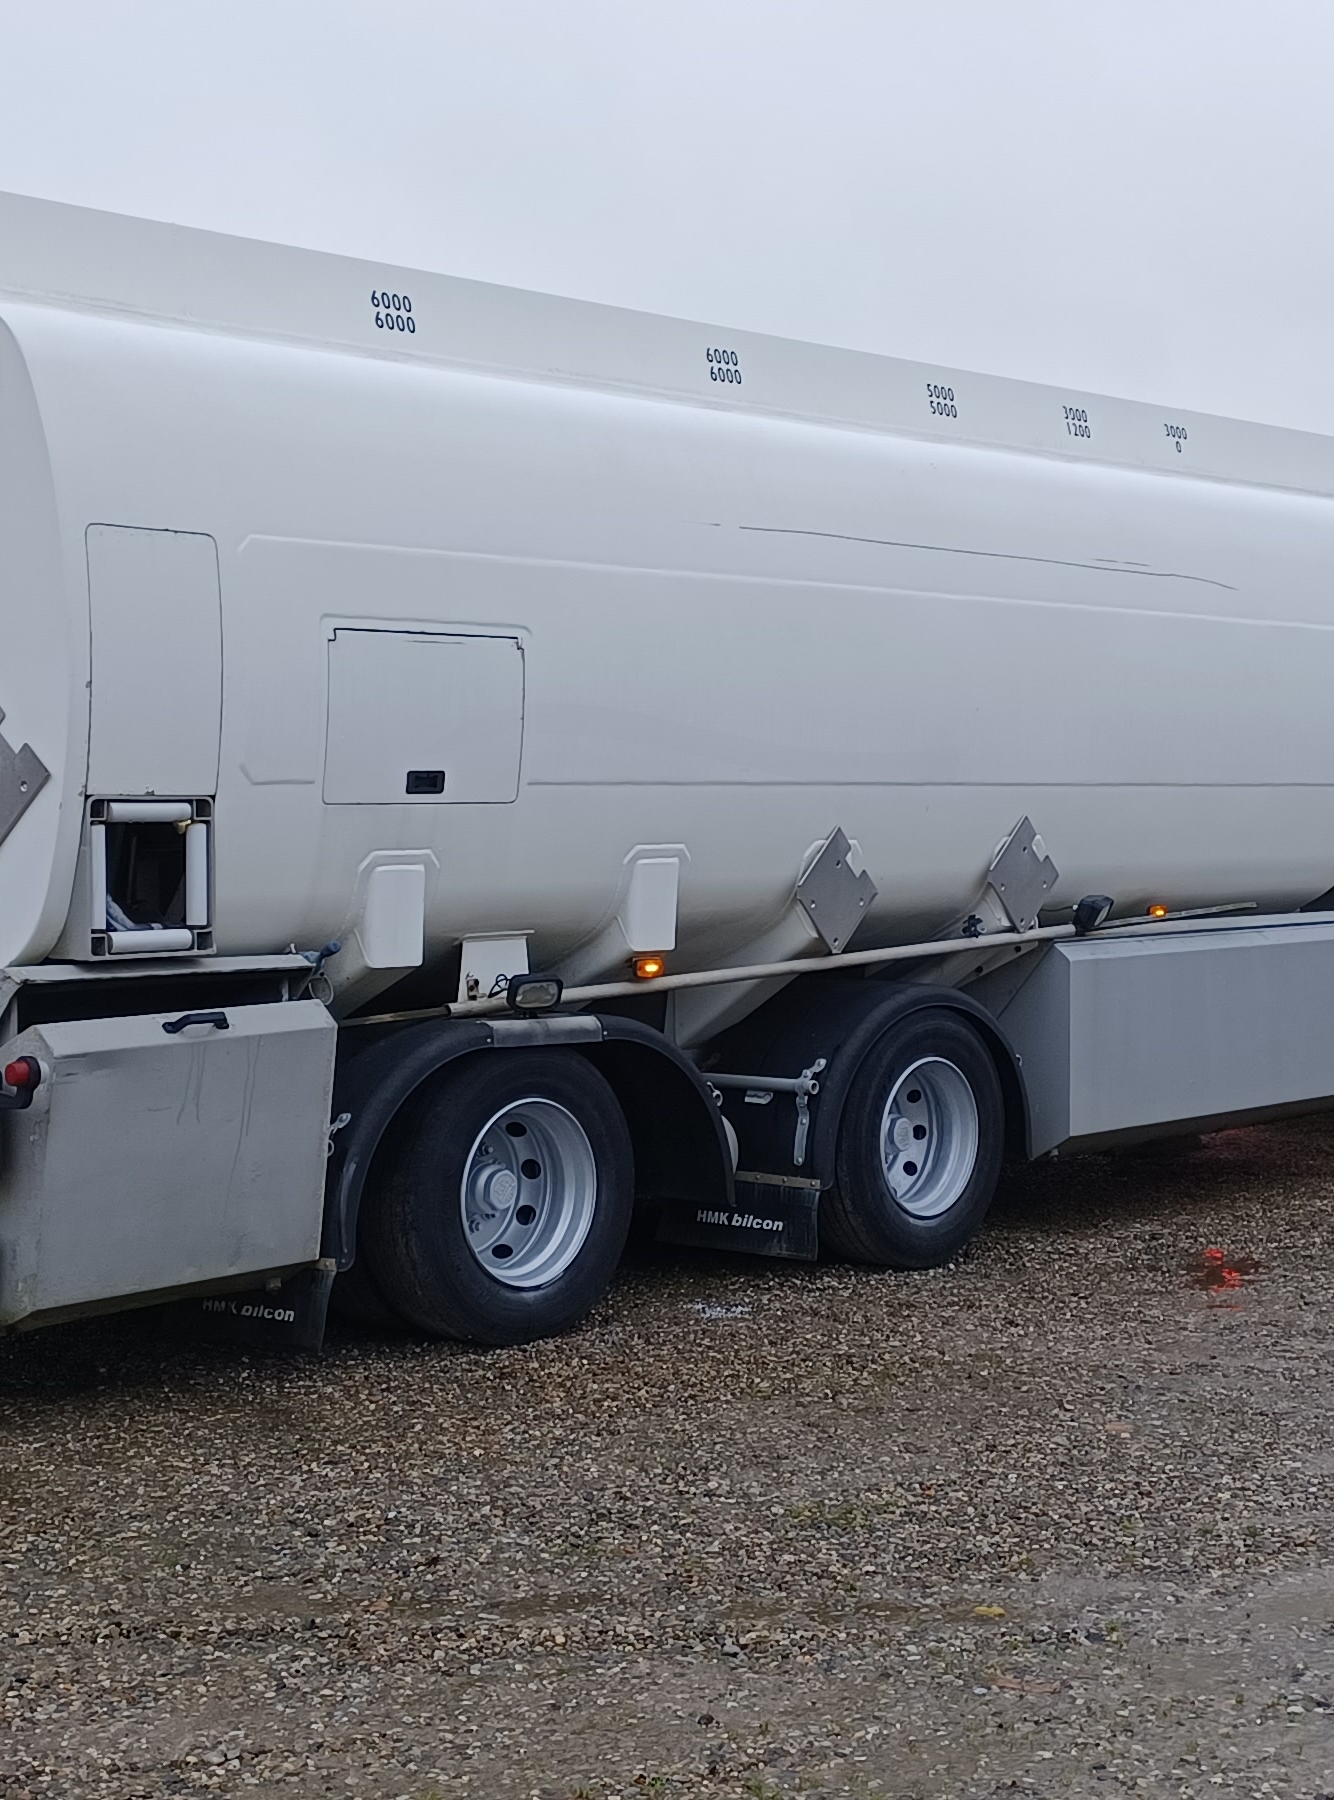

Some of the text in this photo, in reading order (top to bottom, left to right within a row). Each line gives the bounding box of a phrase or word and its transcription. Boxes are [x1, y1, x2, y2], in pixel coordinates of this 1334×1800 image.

[370, 289, 412, 314] 6000
[374, 310, 416, 334] 6000
[706, 347, 739, 367] 6000
[709, 365, 742, 385] 6000
[926, 383, 955, 402] 5000
[929, 400, 958, 419] 5000
[1062, 405, 1088, 423] 3000
[1066, 421, 1091, 439] 1200
[1164, 423, 1188, 440] 3000
[1175, 440, 1182, 453] 0
[696, 1209, 784, 1232] HMK bilcon
